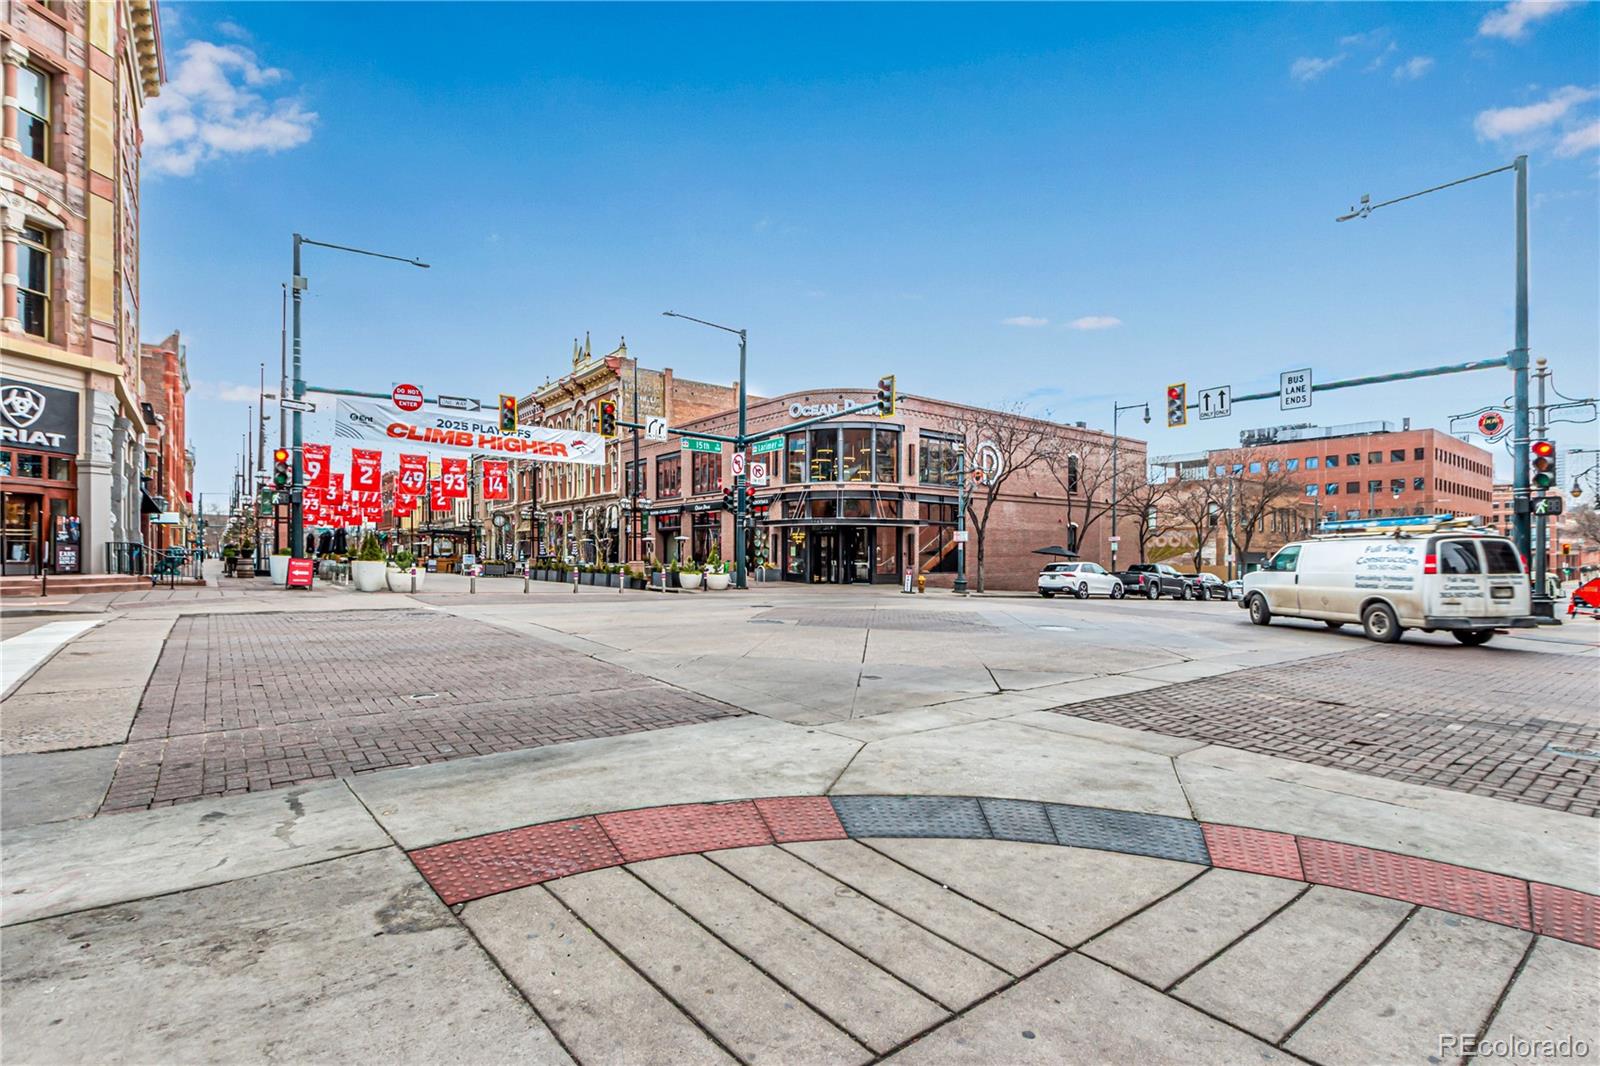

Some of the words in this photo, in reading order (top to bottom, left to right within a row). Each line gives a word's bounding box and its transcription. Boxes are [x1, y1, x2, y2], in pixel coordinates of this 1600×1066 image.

[1287, 375, 1304, 385] BUS
[1285, 384, 1306, 395] LANE
[1285, 395, 1307, 405] ENDS
[436, 418, 468, 431] 2025
[386, 422, 474, 447] CLIMB
[478, 434, 569, 457] HIGHER
[695, 441, 710, 450] 15th
[757, 441, 778, 451] Larimer
[307, 461, 321, 480] 9
[360, 466, 373, 485] 2
[401, 470, 425, 489] 49
[443, 473, 465, 491] 93
[488, 476, 503, 493] 14
[326, 486, 337, 500] 3
[303, 498, 319, 511] 93
